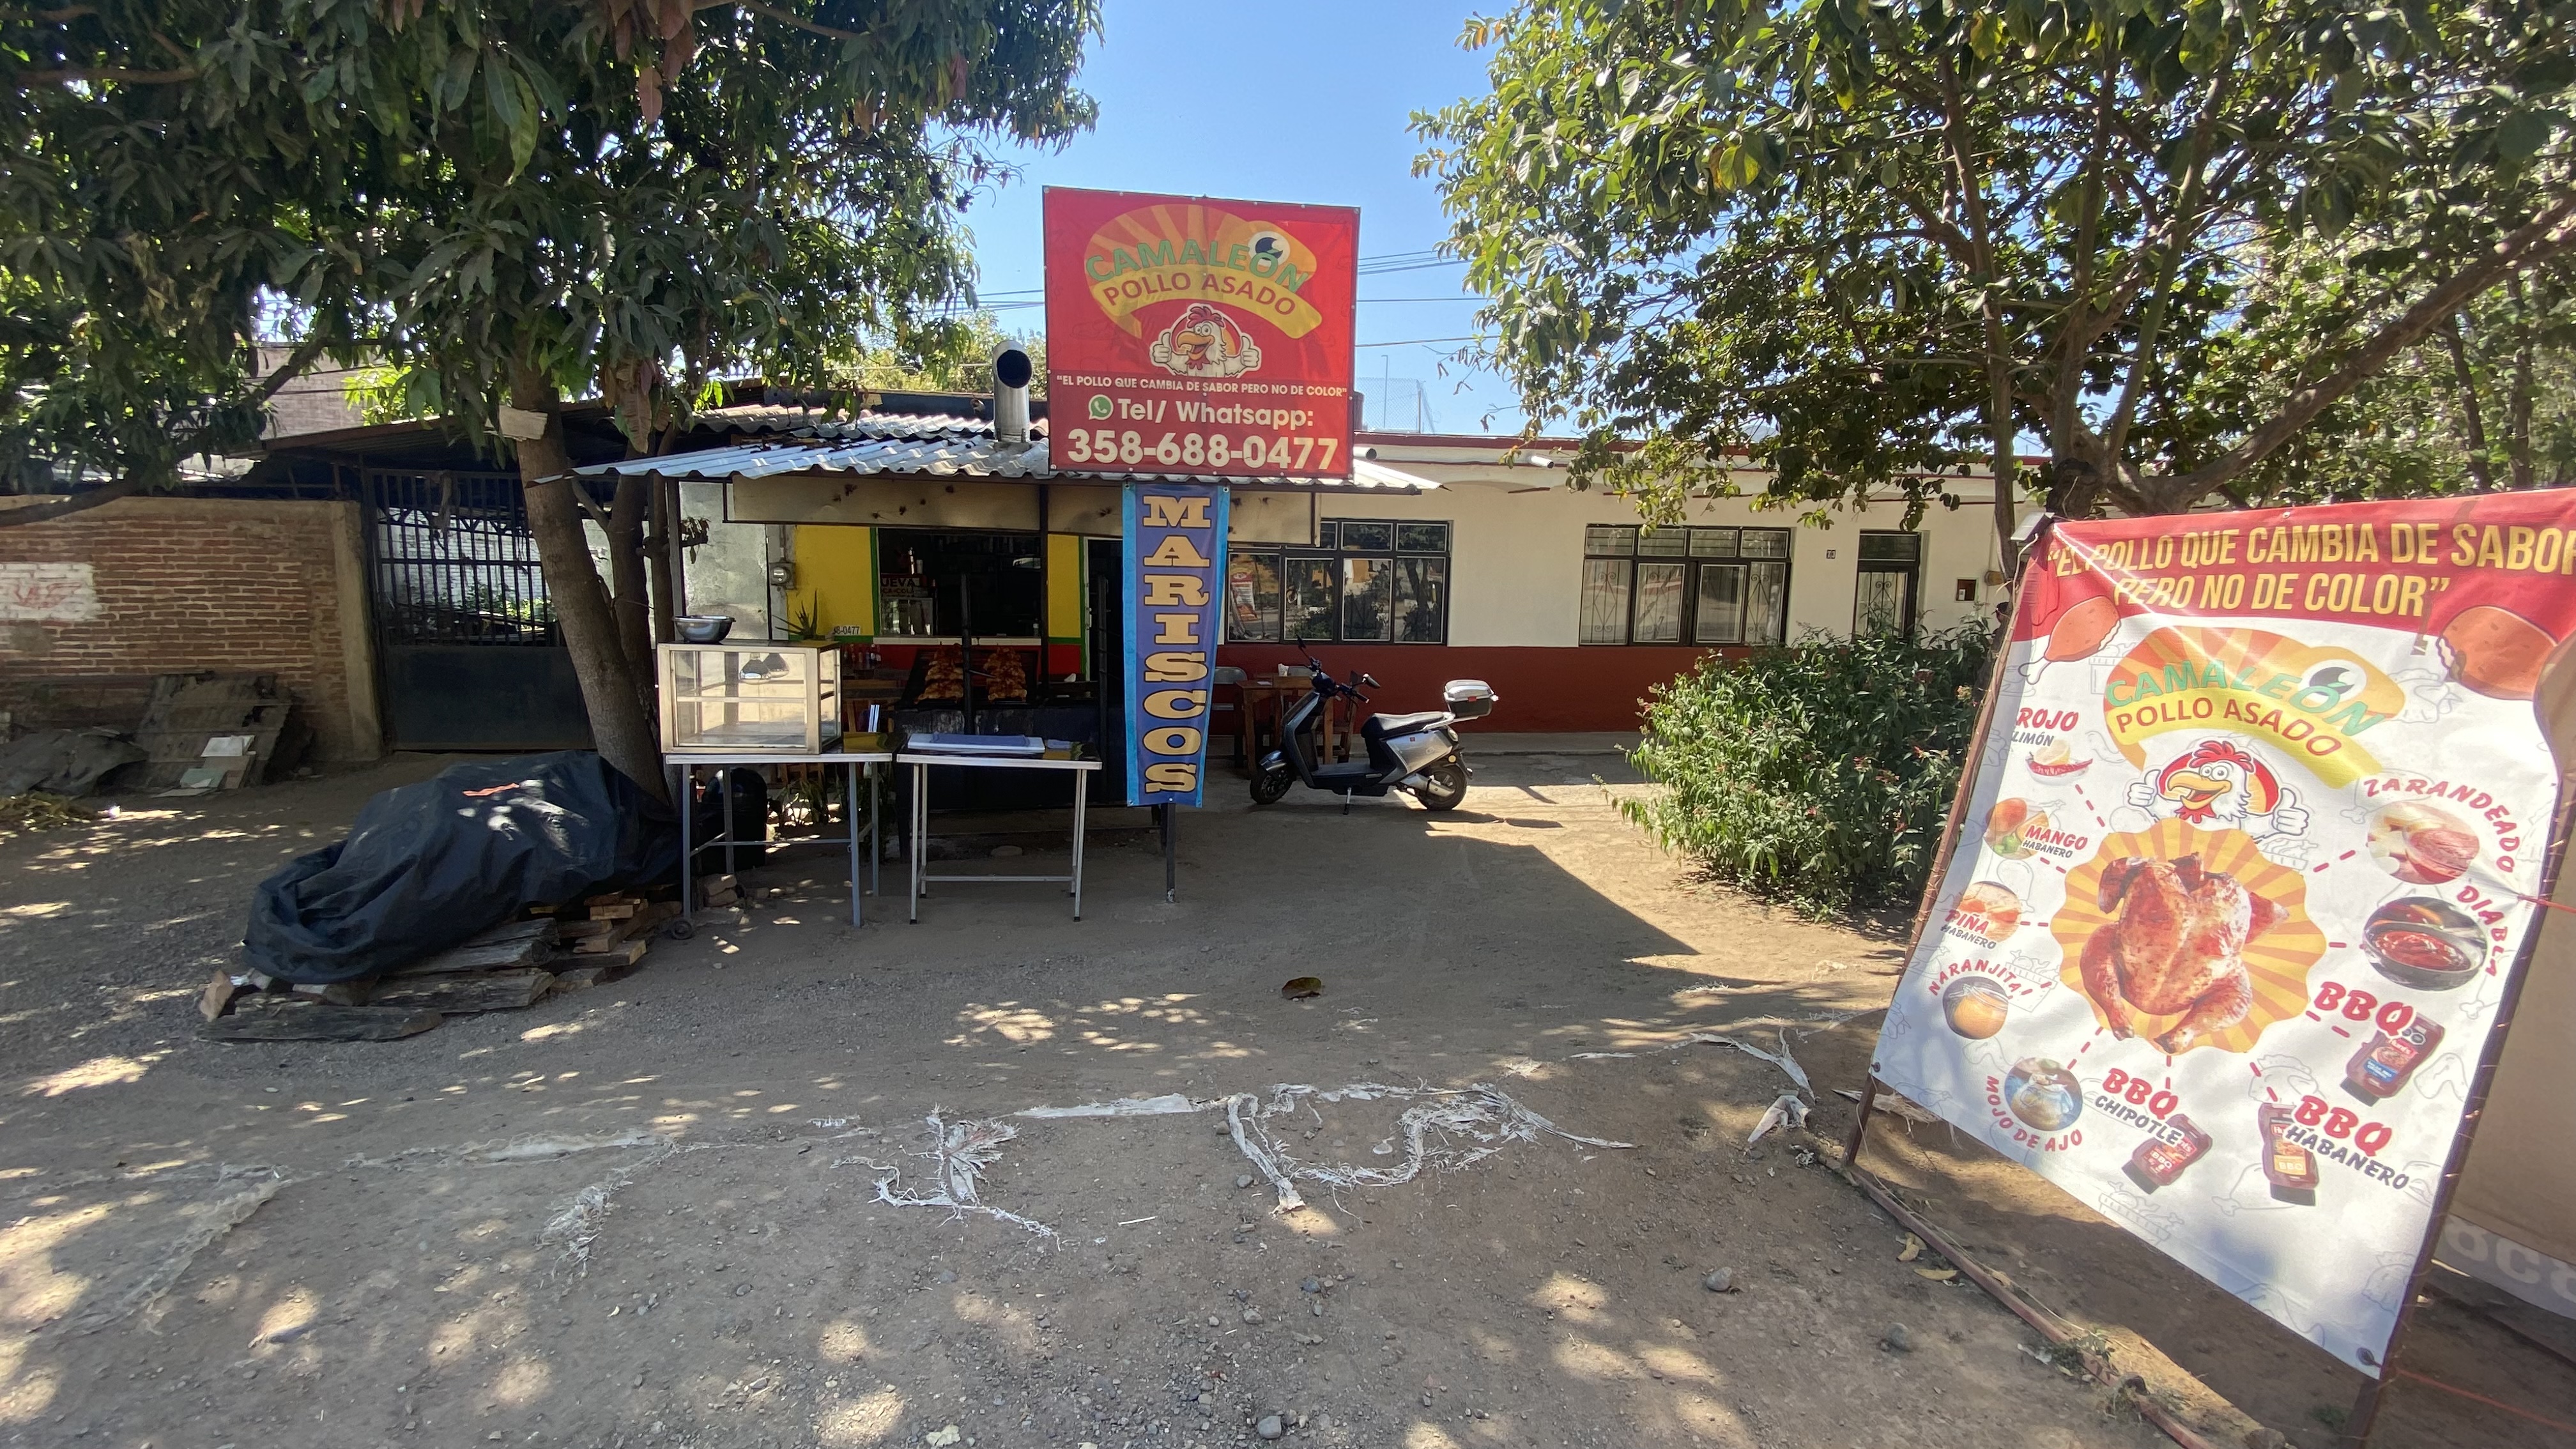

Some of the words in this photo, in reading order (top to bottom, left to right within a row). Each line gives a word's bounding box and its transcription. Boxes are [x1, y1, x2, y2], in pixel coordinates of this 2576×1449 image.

[1103, 273, 1191, 305] POLLO
[1202, 273, 1296, 315] ASADO
[1077, 376, 1112, 387] POLLO
[1115, 378, 1137, 388] QUE
[1140, 379, 1183, 390] CAMBIA
[1186, 381, 1200, 391] DE
[1203, 382, 1238, 392] SABOR
[1241, 383, 1268, 394] PERO
[1271, 385, 1288, 395] NO
[1291, 385, 1303, 395] DE
[1117, 398, 1167, 423] Tel/
[1176, 401, 1313, 431] Whatsapp:
[1068, 428, 1338, 470] 358-688-0477
[2085, 535, 2174, 572] POLLO
[2180, 528, 2239, 569] QUE
[2246, 523, 2379, 564] CAMBIA
[2391, 523, 2439, 564] DE
[2113, 575, 2195, 609] PERO
[2199, 574, 2246, 610] NO
[2251, 573, 2299, 610] DE
[1142, 495, 1212, 794] MARISCOS
[2016, 707, 2079, 732] ROJO
[2116, 697, 2213, 733] POLLO
[2223, 699, 2342, 756] ASADO
[2025, 825, 2088, 850] MANGO
[2364, 778, 2520, 873] ZARANDEADO
[2023, 840, 2073, 858] HABANERO
[1940, 924, 1997, 950] HABANERO
[1945, 909, 1989, 934] PIÑA
[2313, 981, 2414, 1036] BBQ
[1986, 1076, 2014, 1129] MOJO
[2013, 1128, 2040, 1149] DE
[2045, 1129, 2082, 1152] AJO
[2103, 1068, 2179, 1120] BBQ
[2096, 1095, 2182, 1145] CHIPOTLE
[2294, 1094, 2392, 1157] BBQ
[2285, 1126, 2409, 1190] HABANERO
